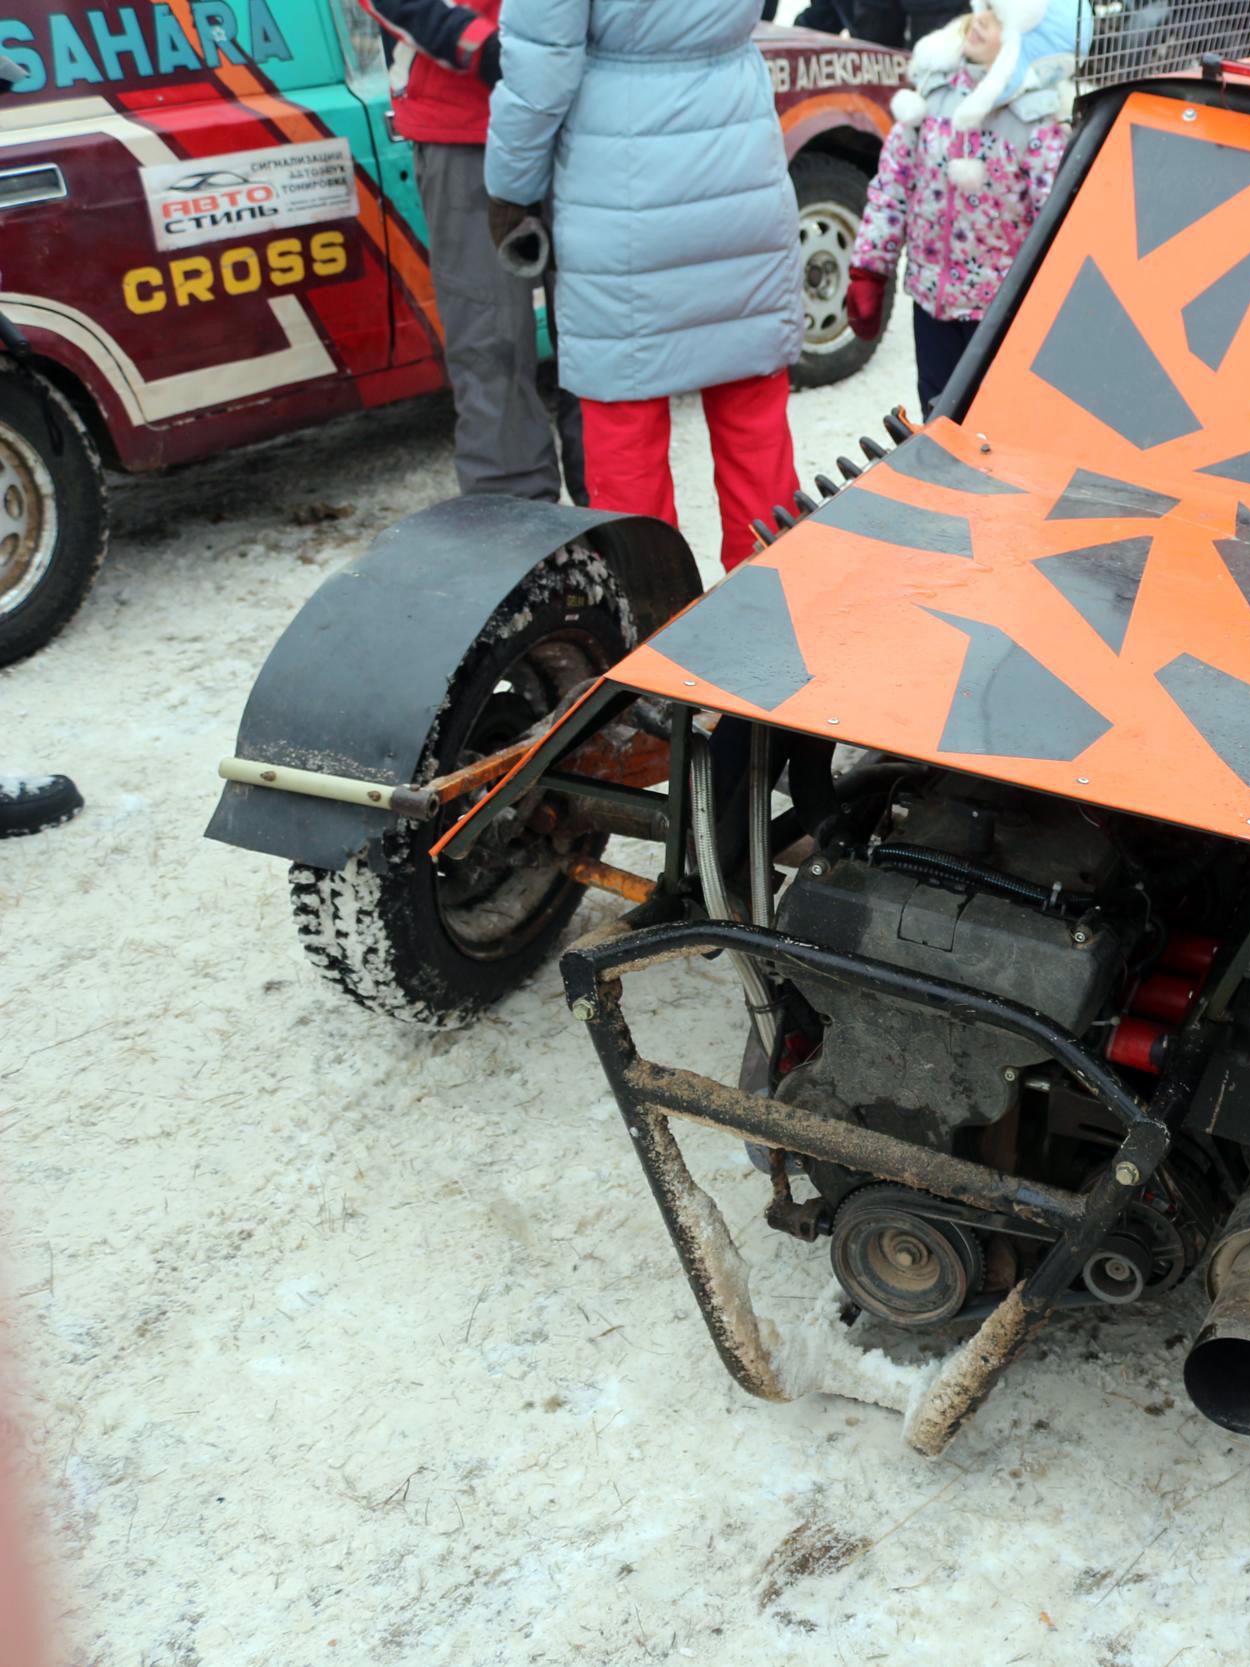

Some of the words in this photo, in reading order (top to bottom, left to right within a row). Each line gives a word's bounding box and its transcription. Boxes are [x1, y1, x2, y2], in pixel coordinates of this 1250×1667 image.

[0, 0, 294, 94] SAHARA
[161, 184, 274, 219] АВТО
[164, 205, 279, 235] СТИЛЬ
[122, 230, 348, 315] CROSS
